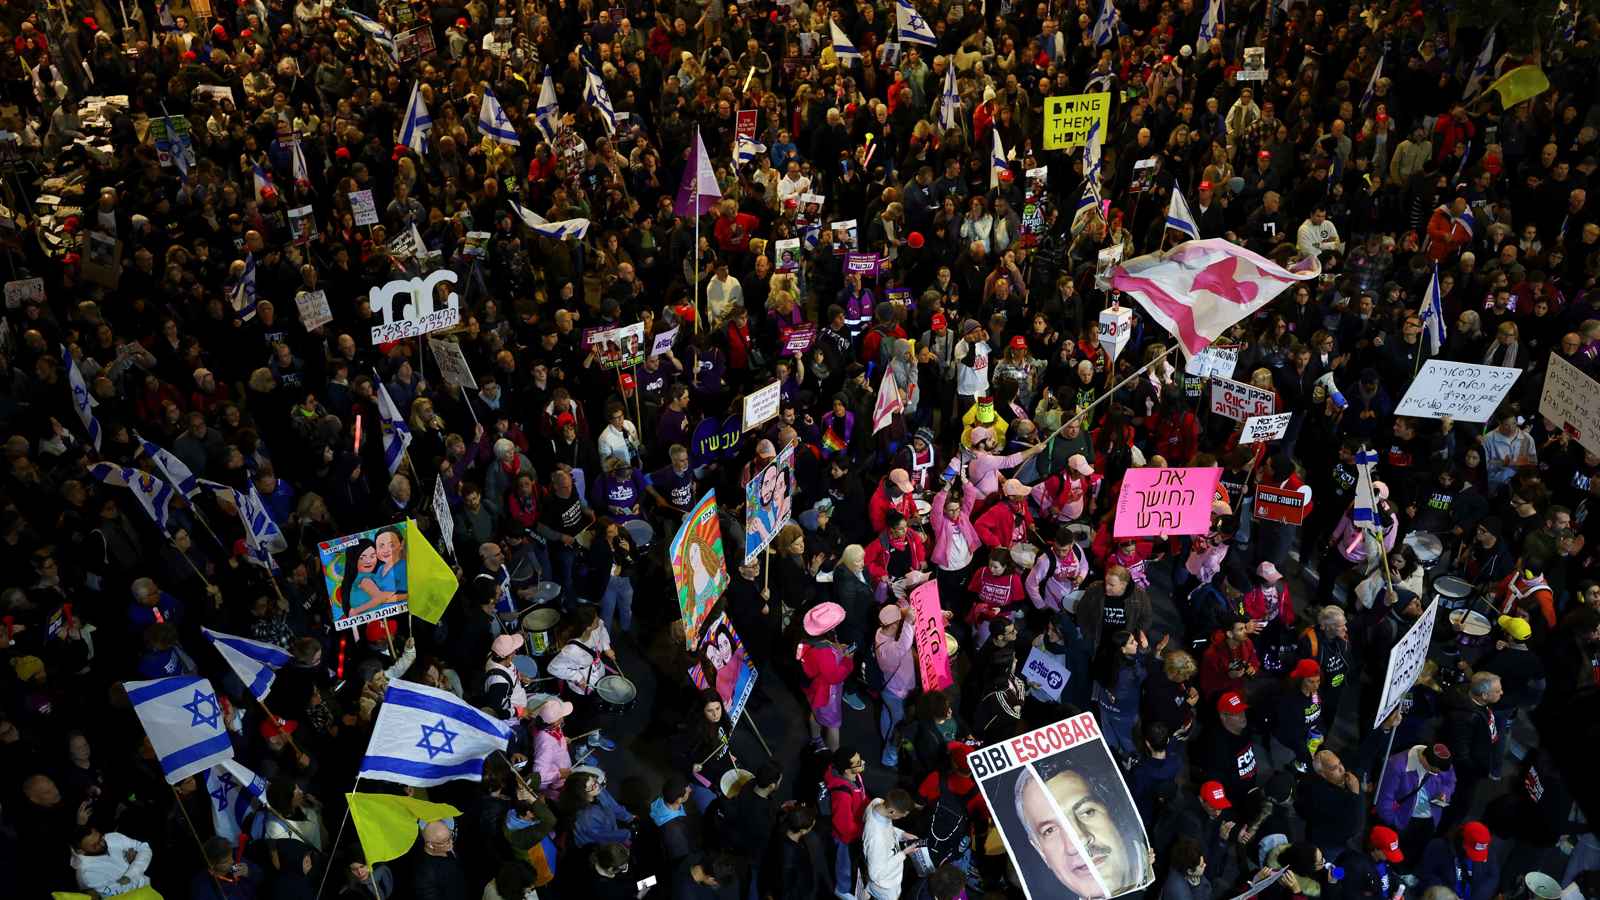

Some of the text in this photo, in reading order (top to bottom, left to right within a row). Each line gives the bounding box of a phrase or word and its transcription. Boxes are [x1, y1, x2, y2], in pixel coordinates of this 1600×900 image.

[1053, 99, 1100, 115] BRING
[1053, 116, 1093, 129] THEM
[1053, 131, 1087, 144] HOM
[1263, 222, 1275, 237] די
[419, 308, 457, 324] החטופים
[1488, 370, 1513, 380] ביבי
[1212, 378, 1271, 401] סביבון סוב סוב סוב
[1458, 379, 1486, 390] תסלח
[1490, 382, 1509, 392] לא
[1215, 401, 1238, 417] הרוב
[700, 430, 739, 454] עכשיו
[1150, 470, 1186, 487] את
[1136, 489, 1195, 513] החושך
[1137, 511, 1181, 529] נגרש
[374, 606, 397, 618] אותה
[970, 714, 1099, 779] BIBI ESCOBAR
[1237, 746, 1254, 768] FCK
